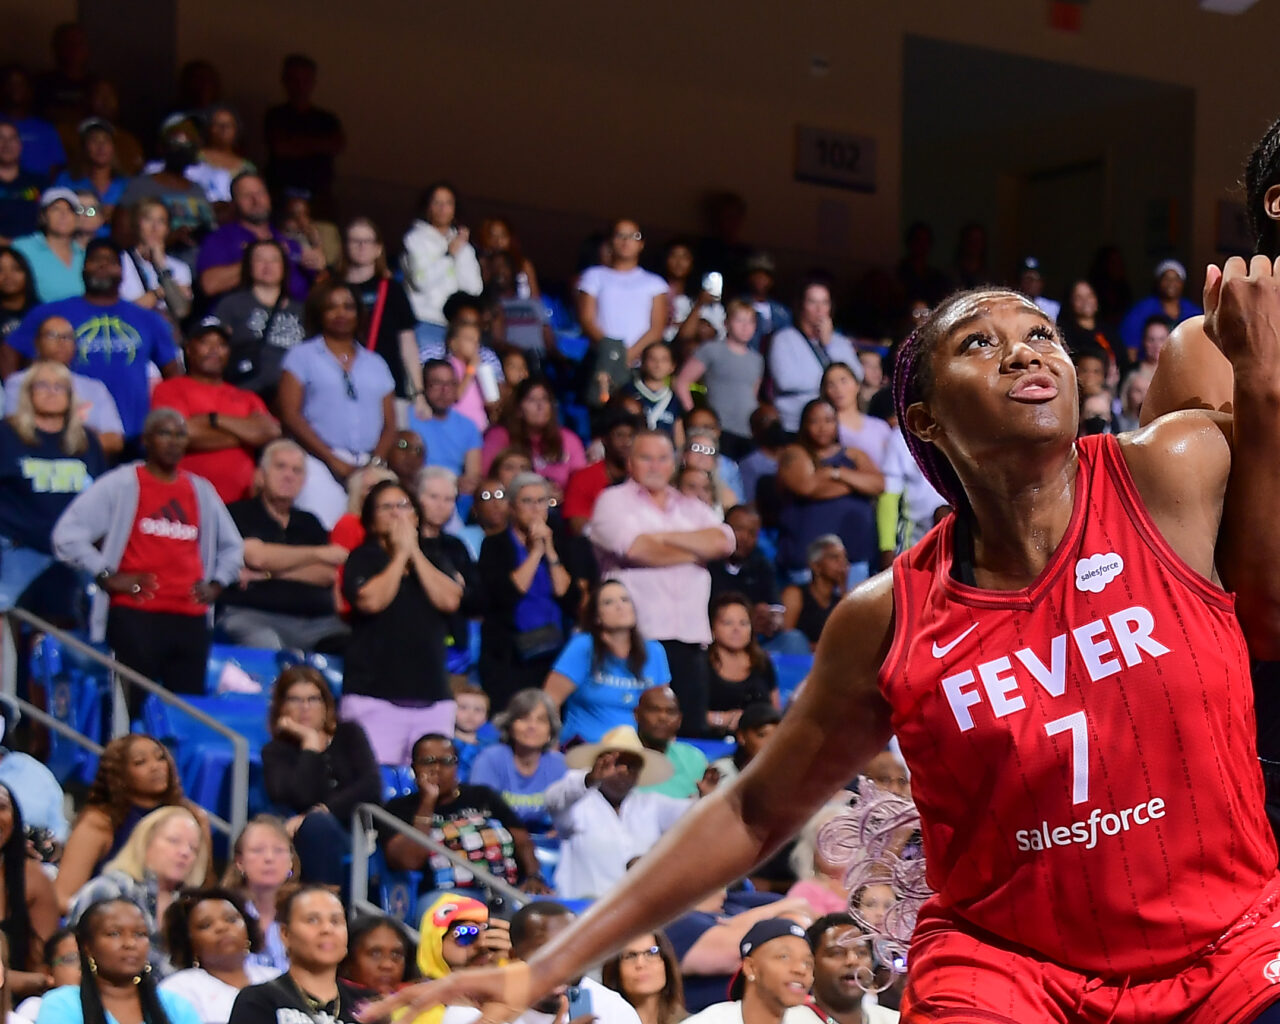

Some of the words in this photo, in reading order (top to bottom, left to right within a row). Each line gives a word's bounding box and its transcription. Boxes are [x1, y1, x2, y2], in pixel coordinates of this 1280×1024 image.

[1080, 560, 1119, 583] salesforce
[941, 606, 1171, 733] FEVER
[1044, 711, 1089, 805] 7
[1015, 797, 1166, 851] salesforce
